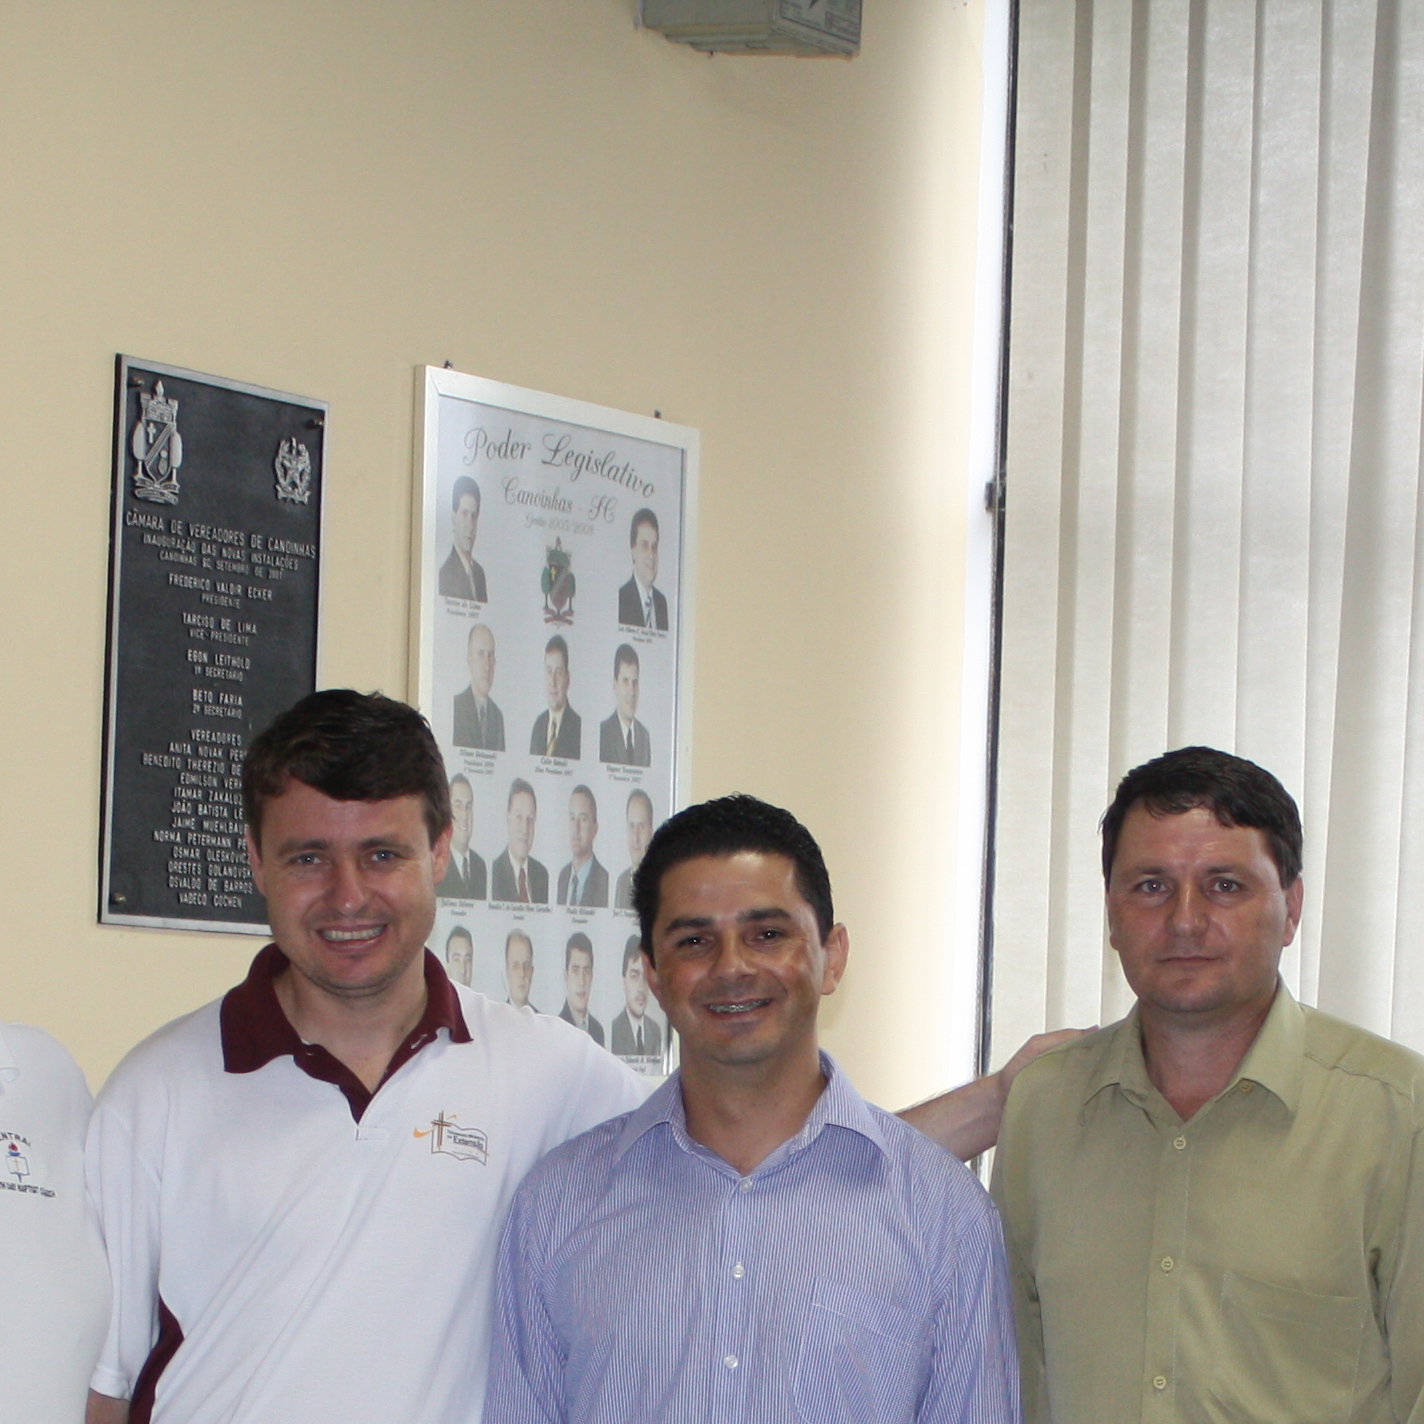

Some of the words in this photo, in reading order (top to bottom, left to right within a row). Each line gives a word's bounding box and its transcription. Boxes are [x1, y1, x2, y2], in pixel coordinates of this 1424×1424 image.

[462, 427, 531, 466] Poder
[541, 433, 656, 498] Legislativo
[502, 476, 573, 514] Canoinhas
[126, 508, 164, 532] CÂMARA
[170, 519, 183, 536] DE
[189, 523, 245, 547] VEREADORES
[250, 534, 263, 550] DE
[268, 536, 317, 559] CANOINHAS
[201, 542, 217, 557] DAS
[169, 572, 211, 592] FREDERICO
[247, 586, 273, 602] ECKER
[201, 592, 241, 610] PRESIDENTE
[182, 612, 214, 630] TARCISO
[221, 617, 231, 632] DE
[237, 621, 257, 635] LIMA
[187, 648, 209, 663] EGON
[215, 653, 250, 670] LEITHOLD
[192, 688, 213, 703] BETO
[219, 692, 243, 707] FARIA
[191, 729, 242, 747] VEREADORES
[169, 742, 192, 755] ANITA
[198, 745, 223, 758] NOVAK
[142, 752, 182, 769] BENEDITO
[187, 758, 225, 775] THEREZIO
[231, 763, 242, 777] DE
[180, 771, 218, 787] EDMILSON
[174, 786, 203, 800] ITAMAR
[171, 799, 192, 815] JOÃO
[197, 803, 228, 818] BATISTA
[171, 816, 196, 831] JAIME
[153, 830, 181, 844] NORMA
[187, 832, 232, 848] PETERMANN
[172, 845, 200, 860] OSMAR
[167, 860, 201, 876] ORESTES
[168, 875, 201, 891] OSVALDO
[207, 878, 218, 892] DE
[224, 879, 253, 895] BARROS
